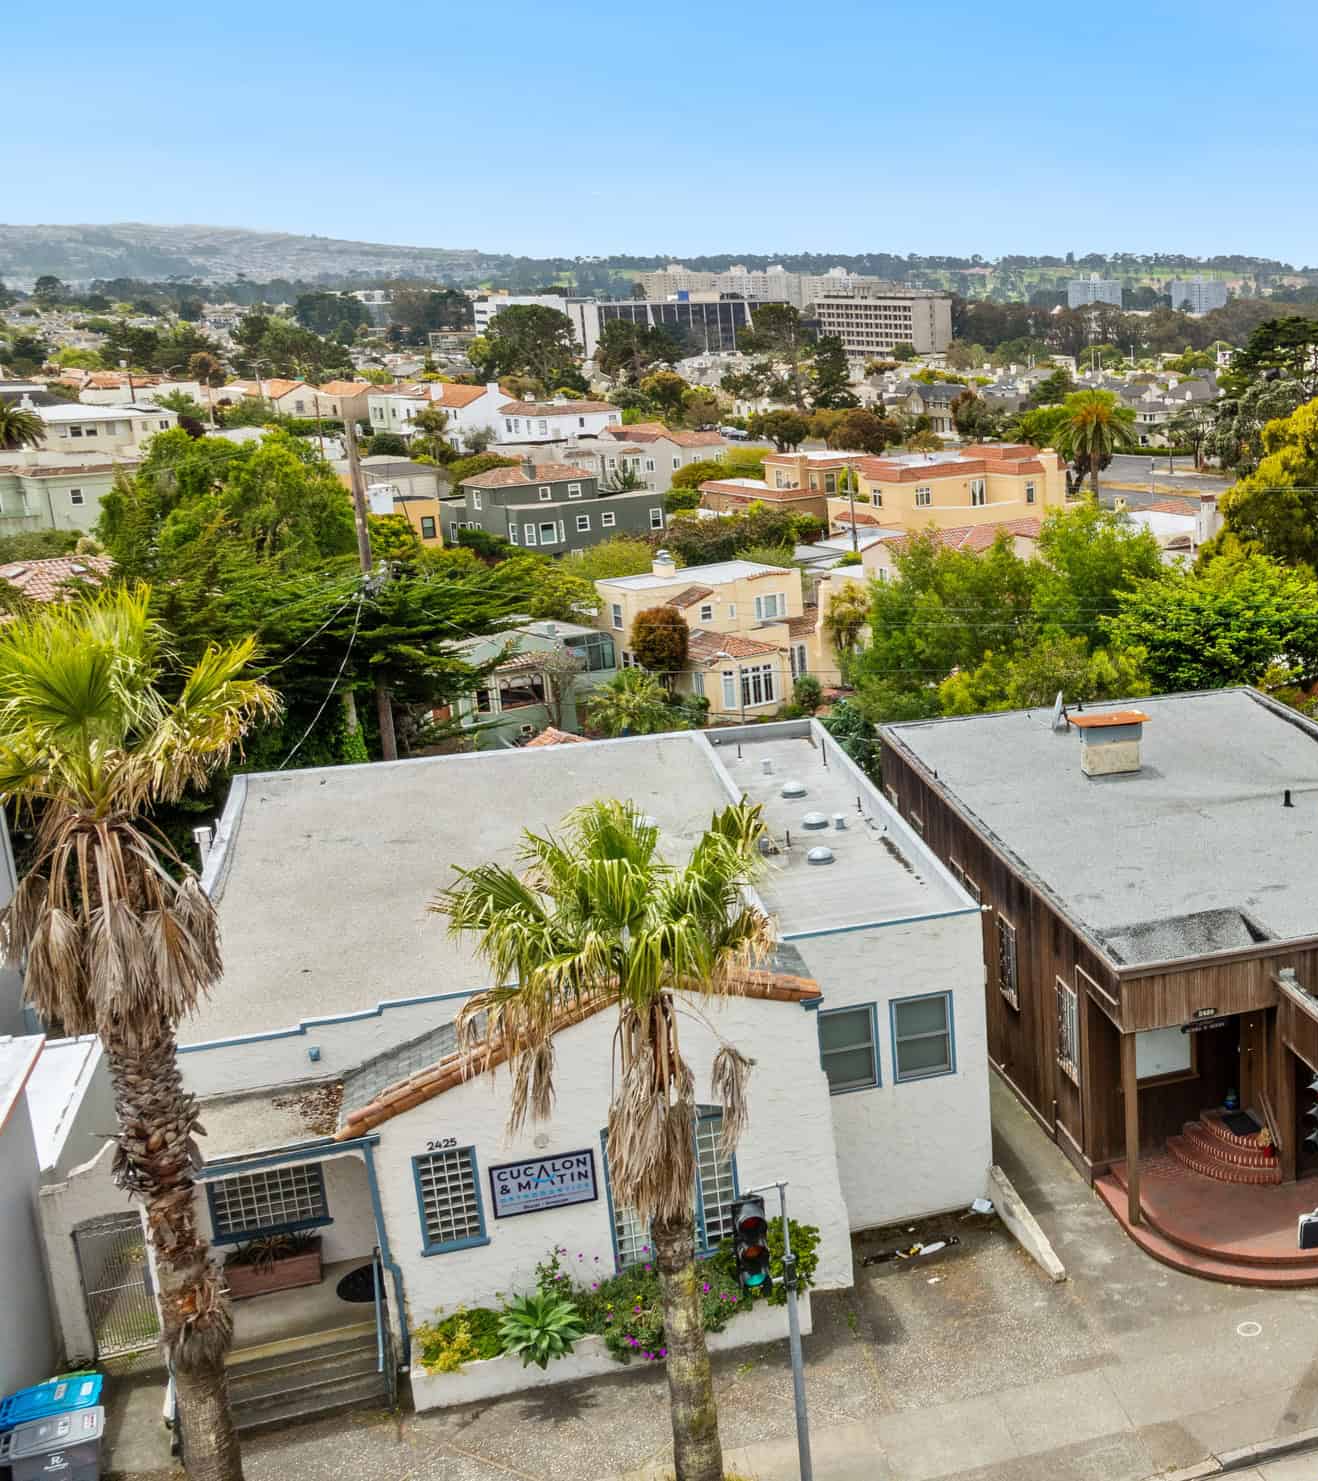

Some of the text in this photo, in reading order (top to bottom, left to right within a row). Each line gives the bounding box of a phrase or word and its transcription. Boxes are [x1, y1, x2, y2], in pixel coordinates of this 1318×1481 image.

[426, 1137, 457, 1151] 2425
[497, 1156, 588, 1182] CUCALON
[500, 1184, 511, 1195] &
